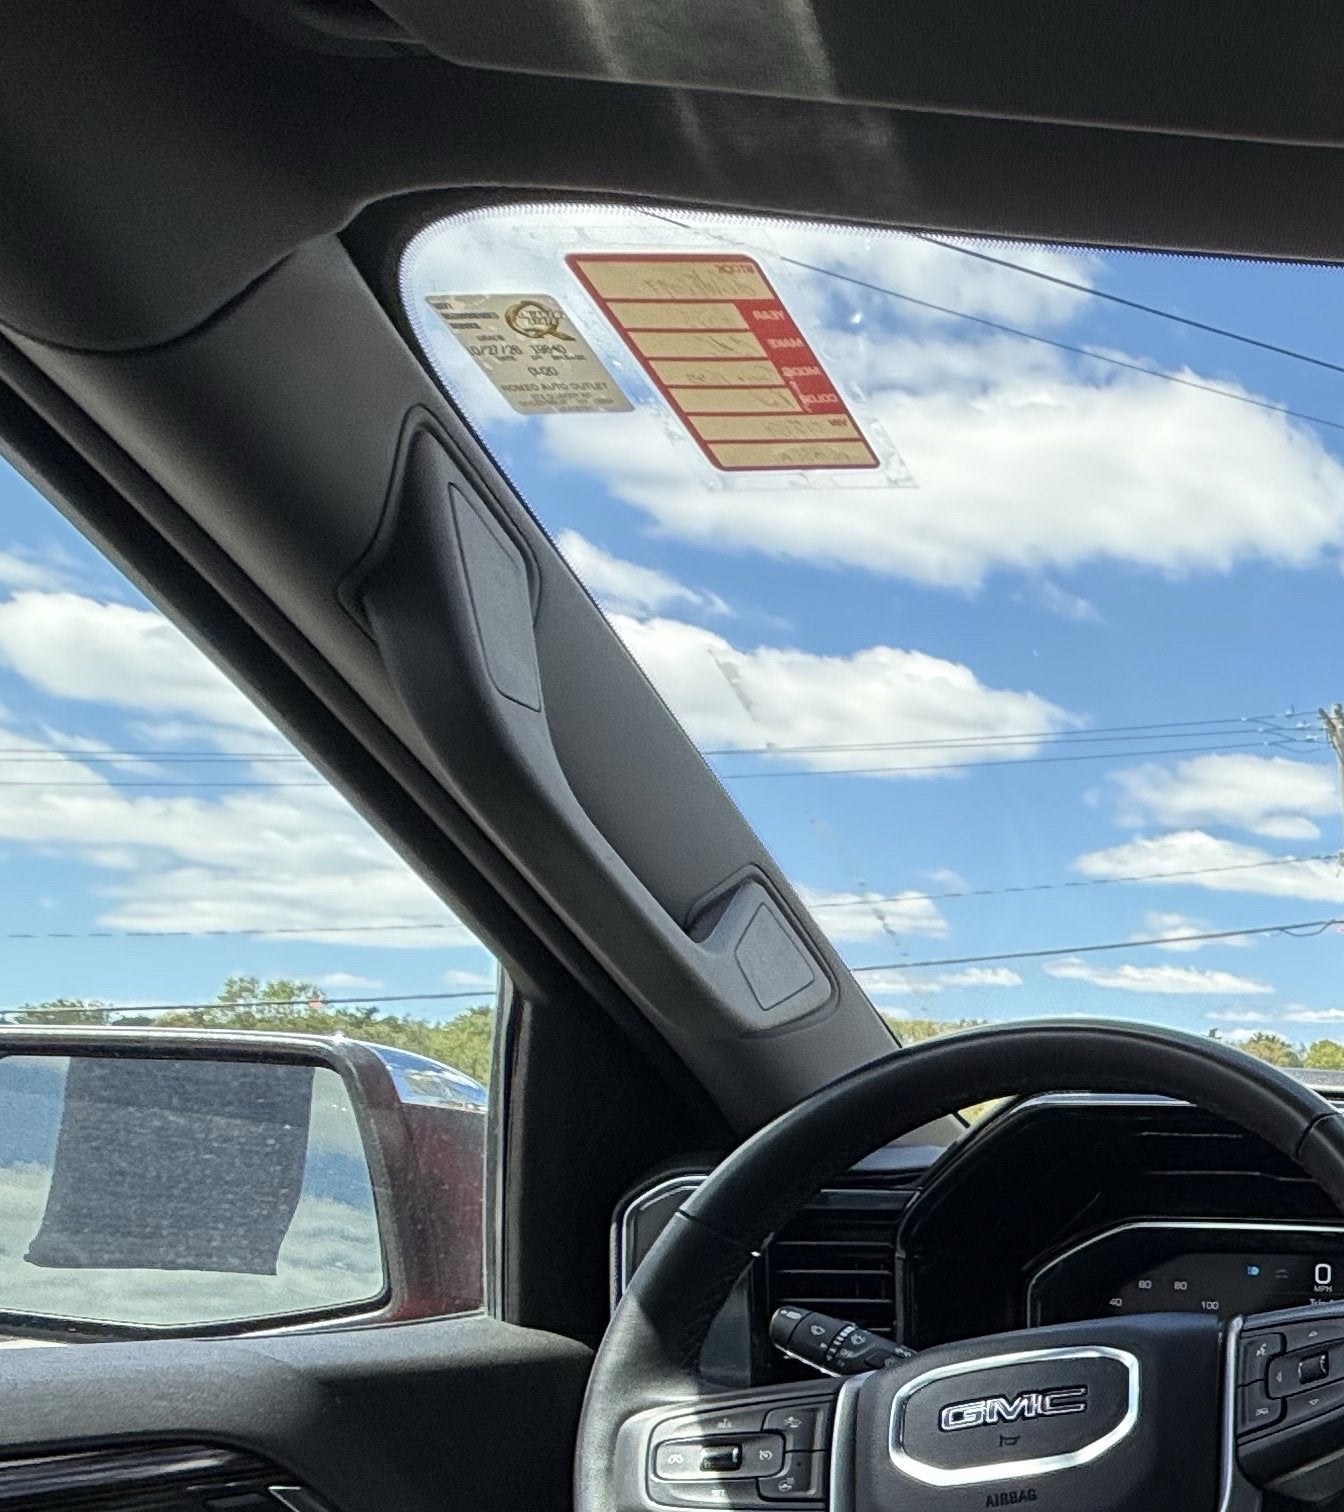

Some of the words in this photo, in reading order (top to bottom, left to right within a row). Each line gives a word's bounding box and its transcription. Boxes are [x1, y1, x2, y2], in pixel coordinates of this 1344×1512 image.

[501, 382, 540, 392] ROMEO
[541, 382, 570, 392] AUTO
[570, 382, 609, 391] OUTLET
[1108, 1297, 1123, 1307] 40
[1201, 1301, 1220, 1310] 100
[939, 1385, 1088, 1432] GMC
[985, 1488, 1038, 1509] AIRBAG
